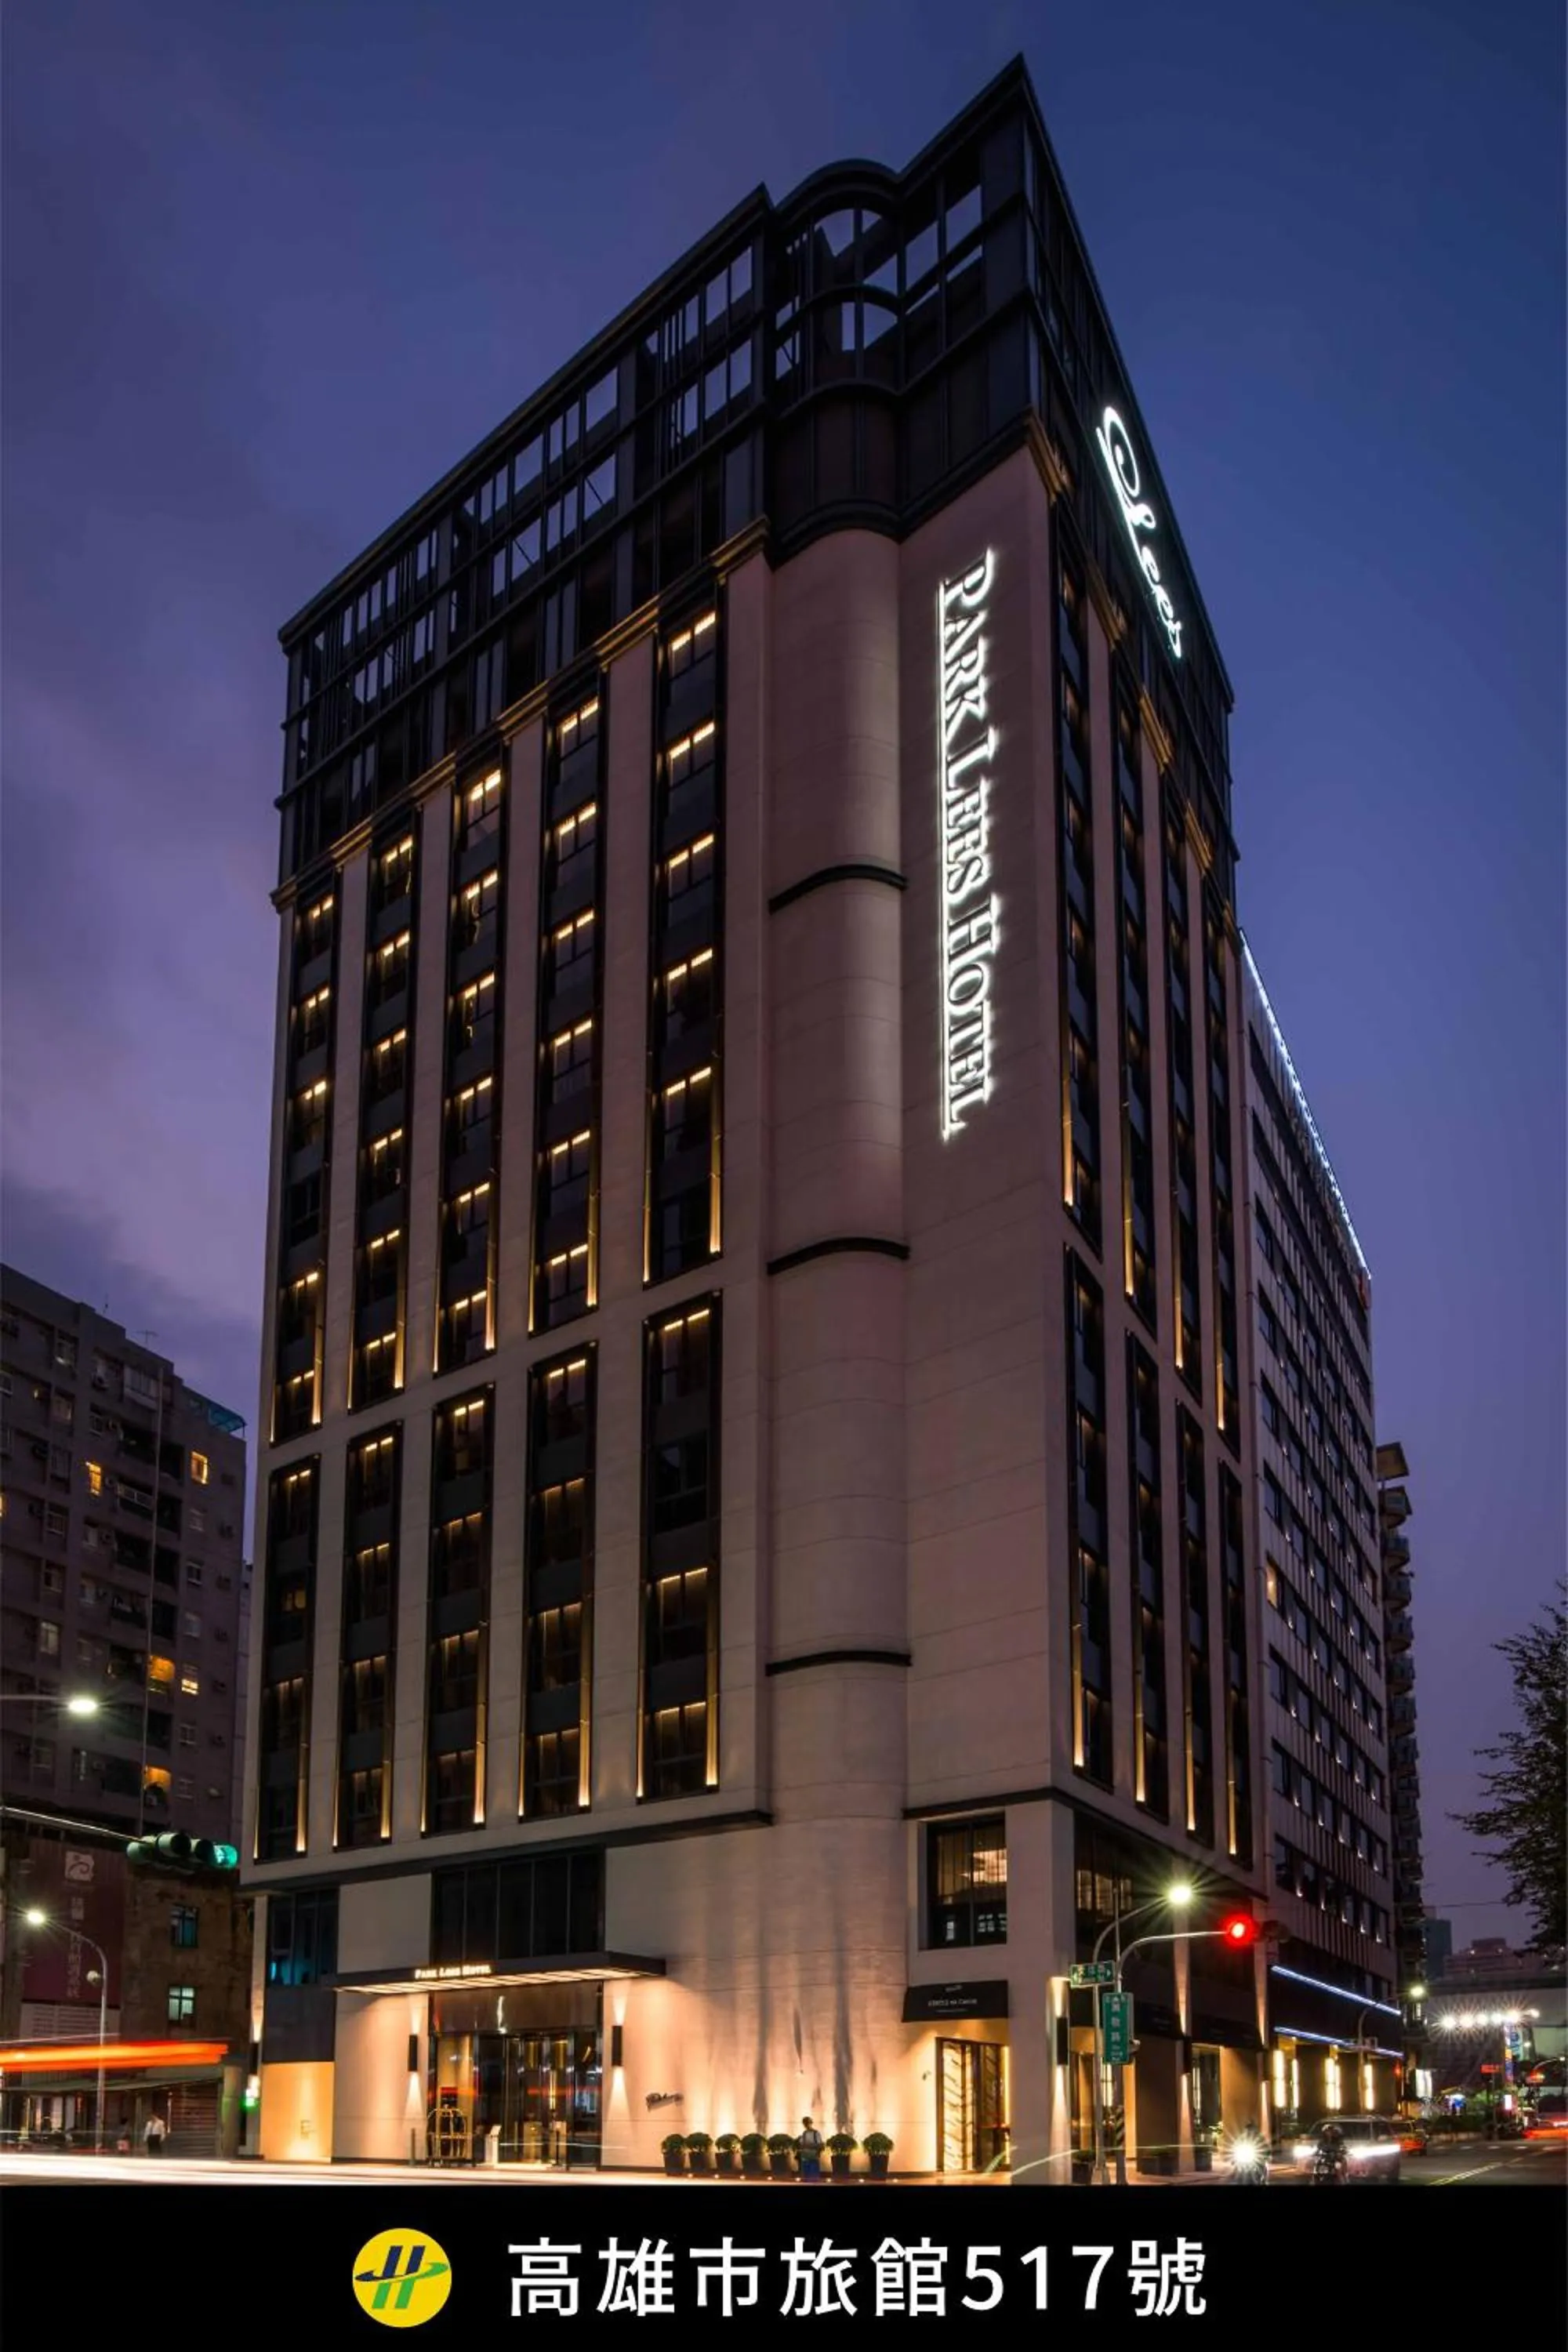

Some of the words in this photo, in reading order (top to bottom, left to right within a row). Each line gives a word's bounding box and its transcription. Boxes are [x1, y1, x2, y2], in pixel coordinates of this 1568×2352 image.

[1095, 406, 1181, 659] Lees
[941, 547, 996, 744] PARK
[942, 724, 999, 903] LEES
[945, 892, 1001, 1131] HOTEL
